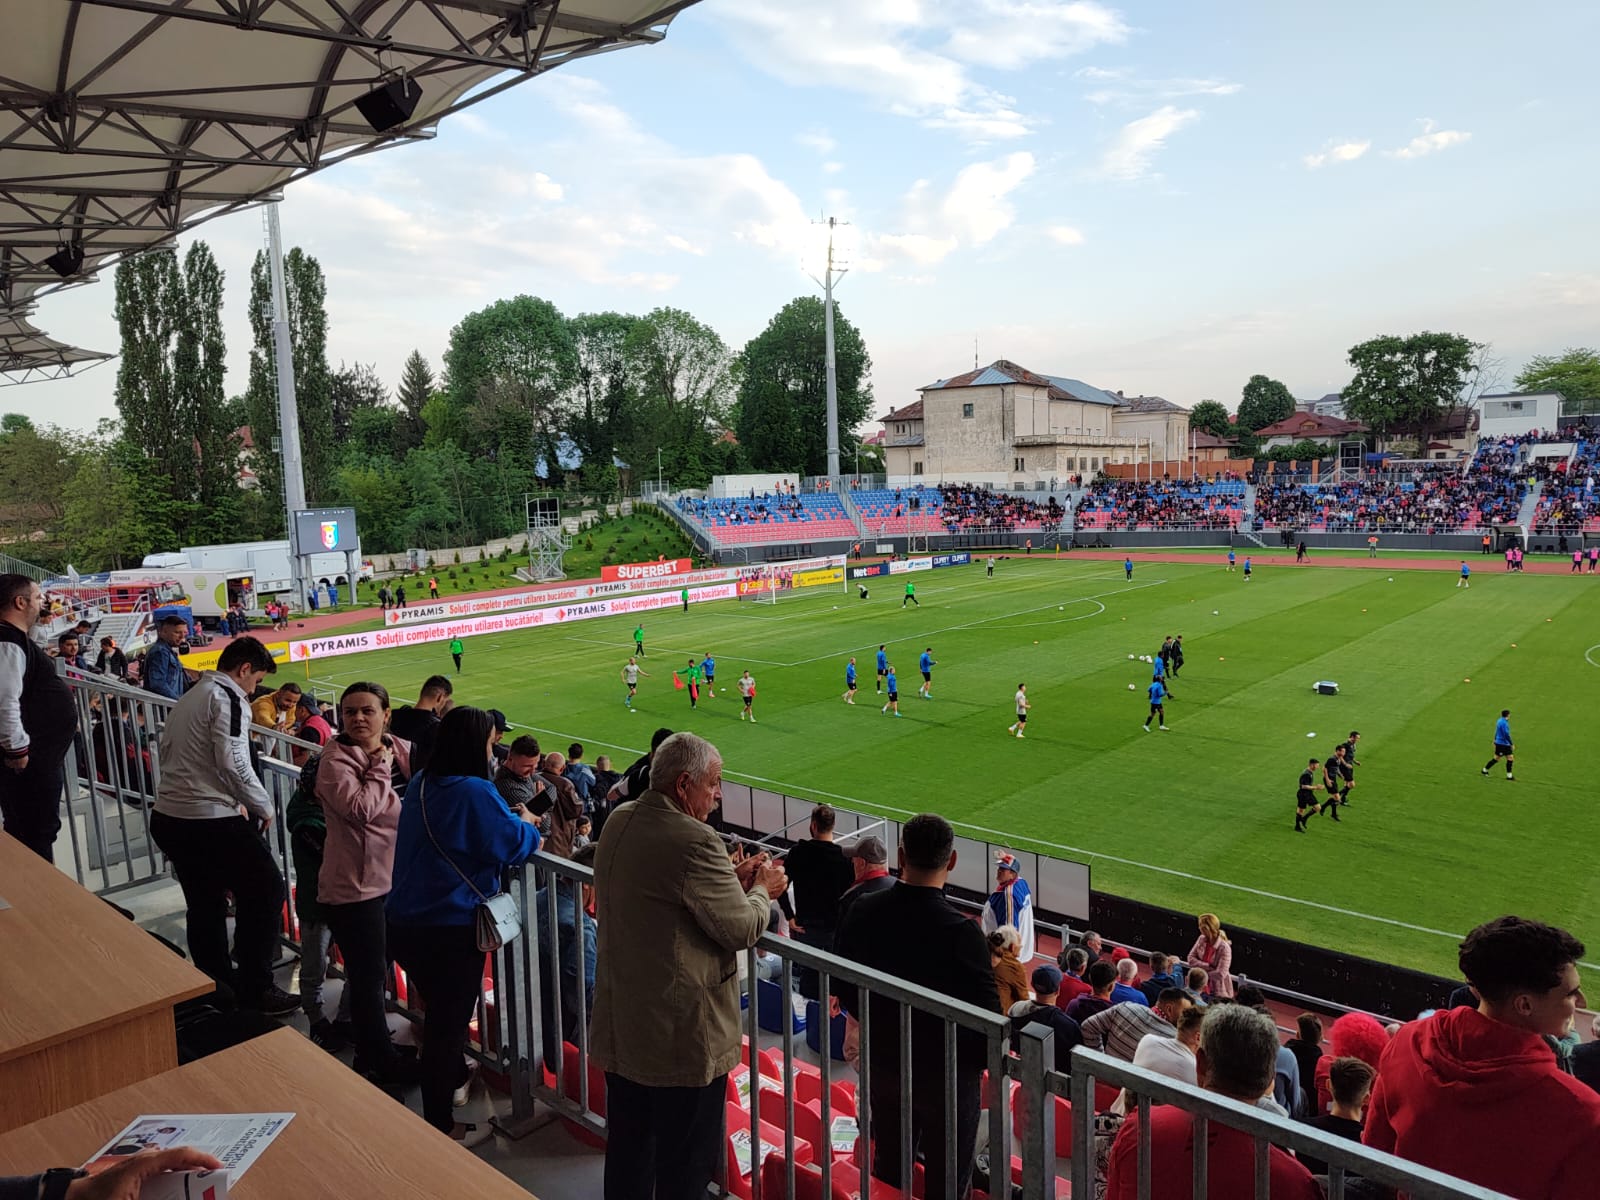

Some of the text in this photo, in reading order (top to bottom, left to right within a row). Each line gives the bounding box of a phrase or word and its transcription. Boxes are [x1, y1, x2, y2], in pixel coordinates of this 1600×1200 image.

[617, 560, 678, 579] SUPERBET
[853, 566, 881, 578] NetBet
[595, 583, 627, 593] PYRAMIS
[401, 606, 444, 620] PYRAMIS
[472, 600, 502, 613] complete
[503, 596, 523, 609] pentru
[524, 592, 547, 605] utilarea
[567, 603, 606, 617] PYRAMIS
[632, 597, 660, 611] complete
[660, 593, 679, 607] pentru
[312, 636, 369, 653] PYRAMIS
[406, 627, 446, 643] complete
[447, 622, 472, 639] pentru
[474, 617, 503, 632] utilarea
[231, 740, 253, 784] ATHLETIC
[226, 1139, 257, 1169] adeptul
